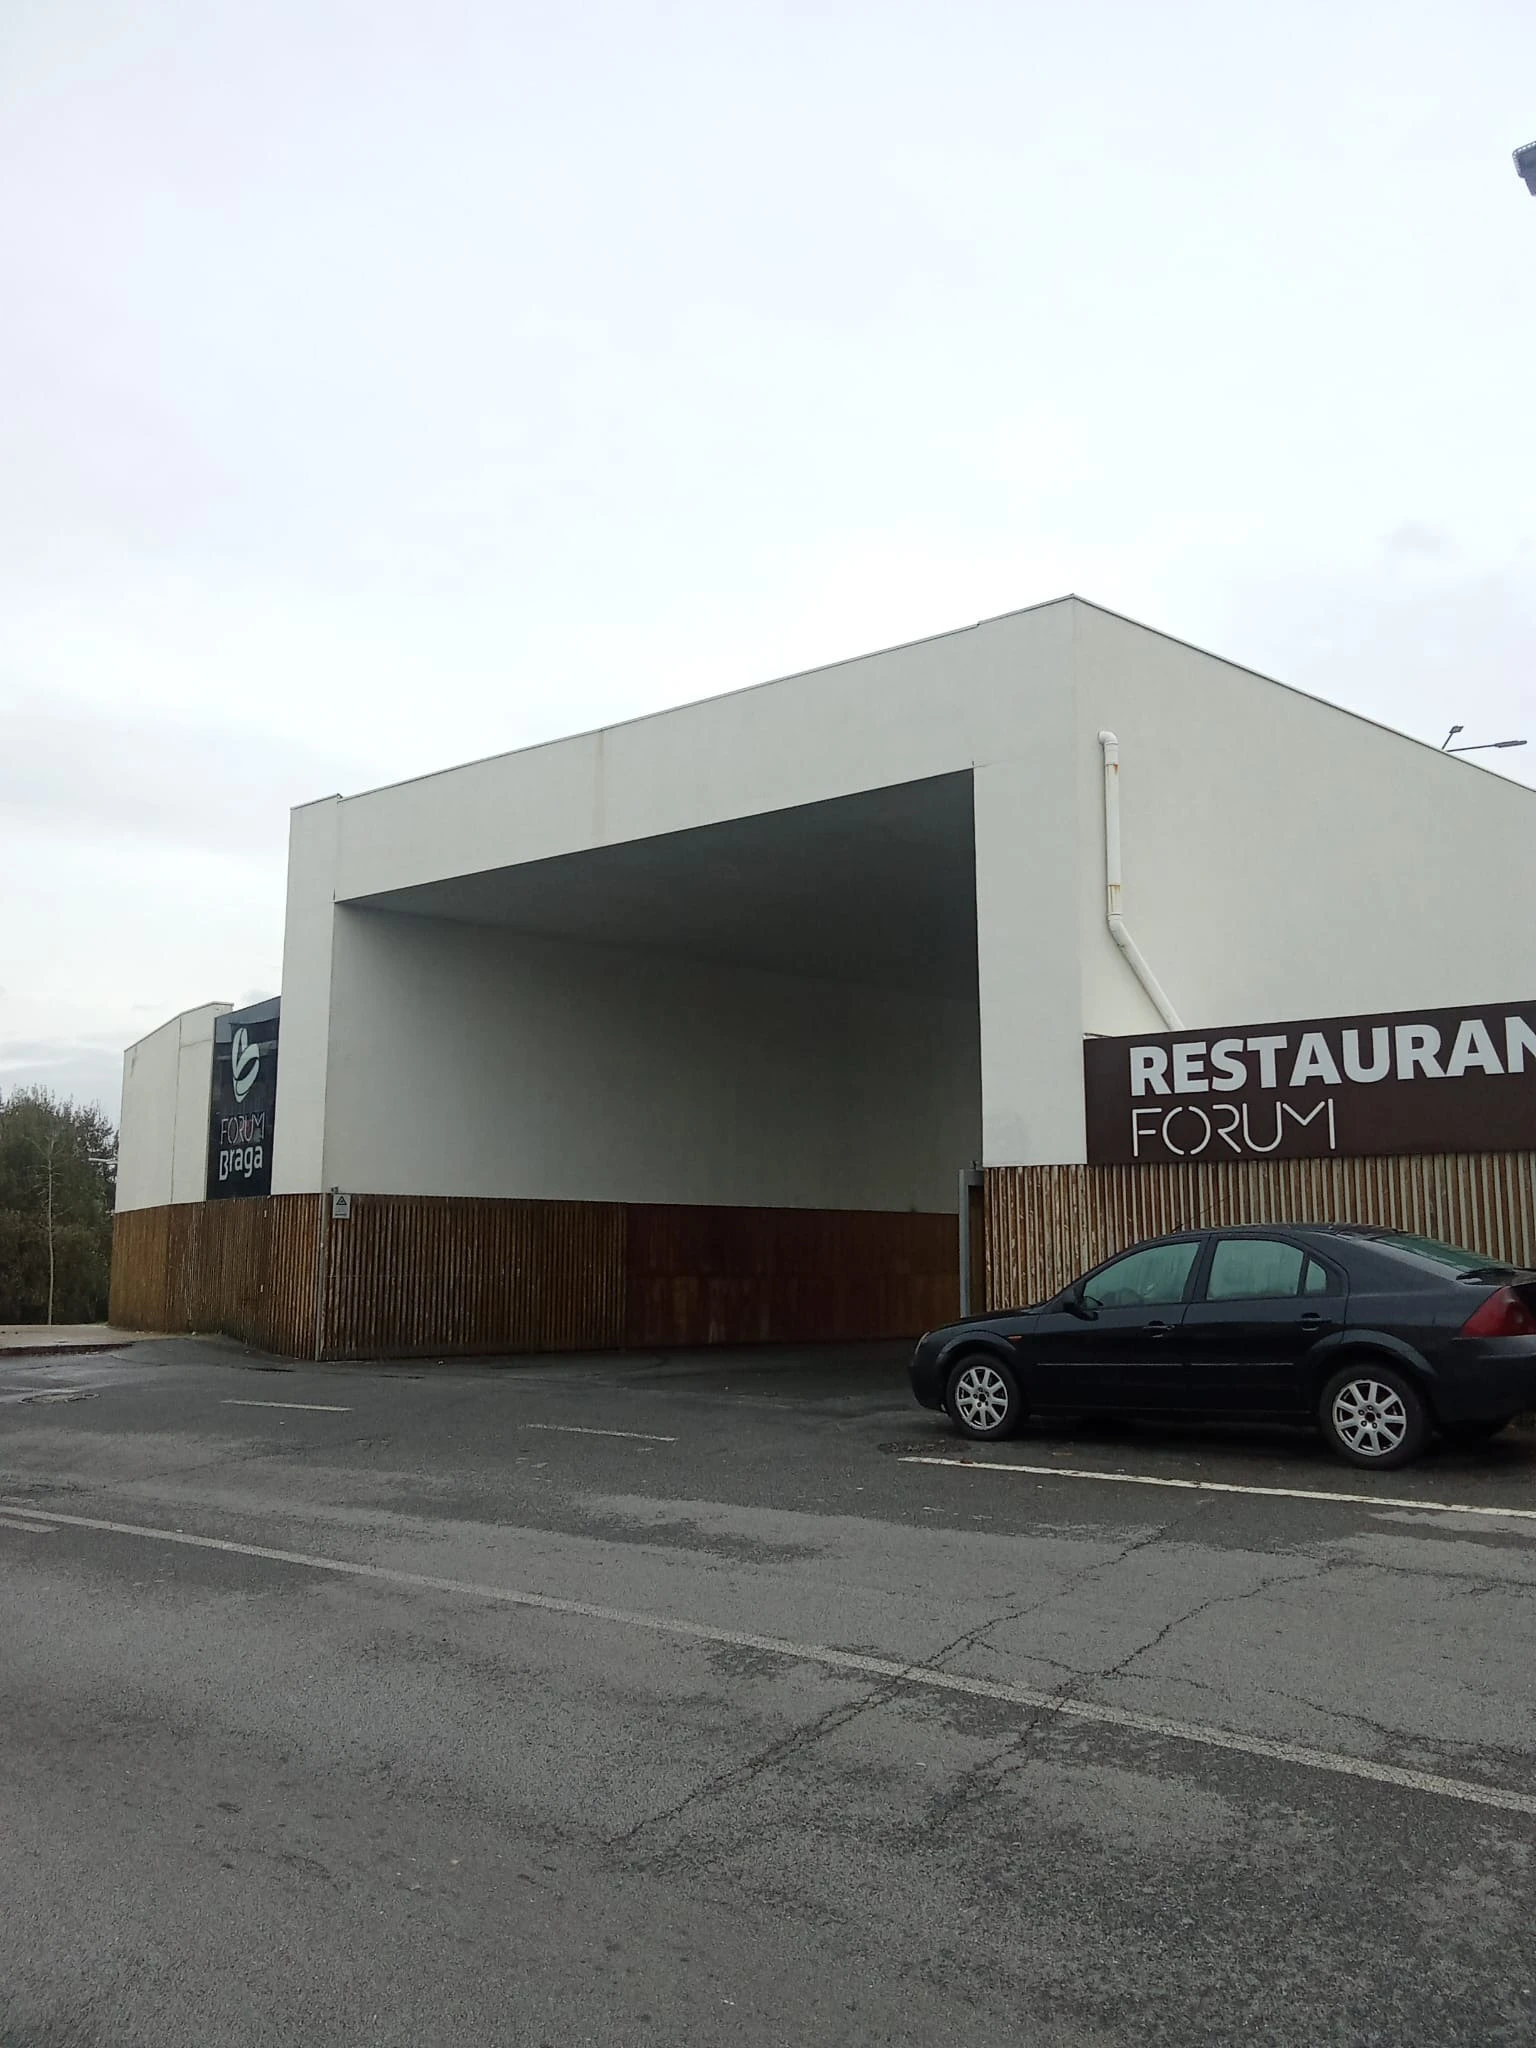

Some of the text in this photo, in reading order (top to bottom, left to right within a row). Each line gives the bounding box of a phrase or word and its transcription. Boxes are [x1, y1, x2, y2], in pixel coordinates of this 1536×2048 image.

[220, 1111, 265, 1145] FORUM
[1132, 1098, 1336, 1157] FORUM
[218, 1145, 263, 1181] Braga
